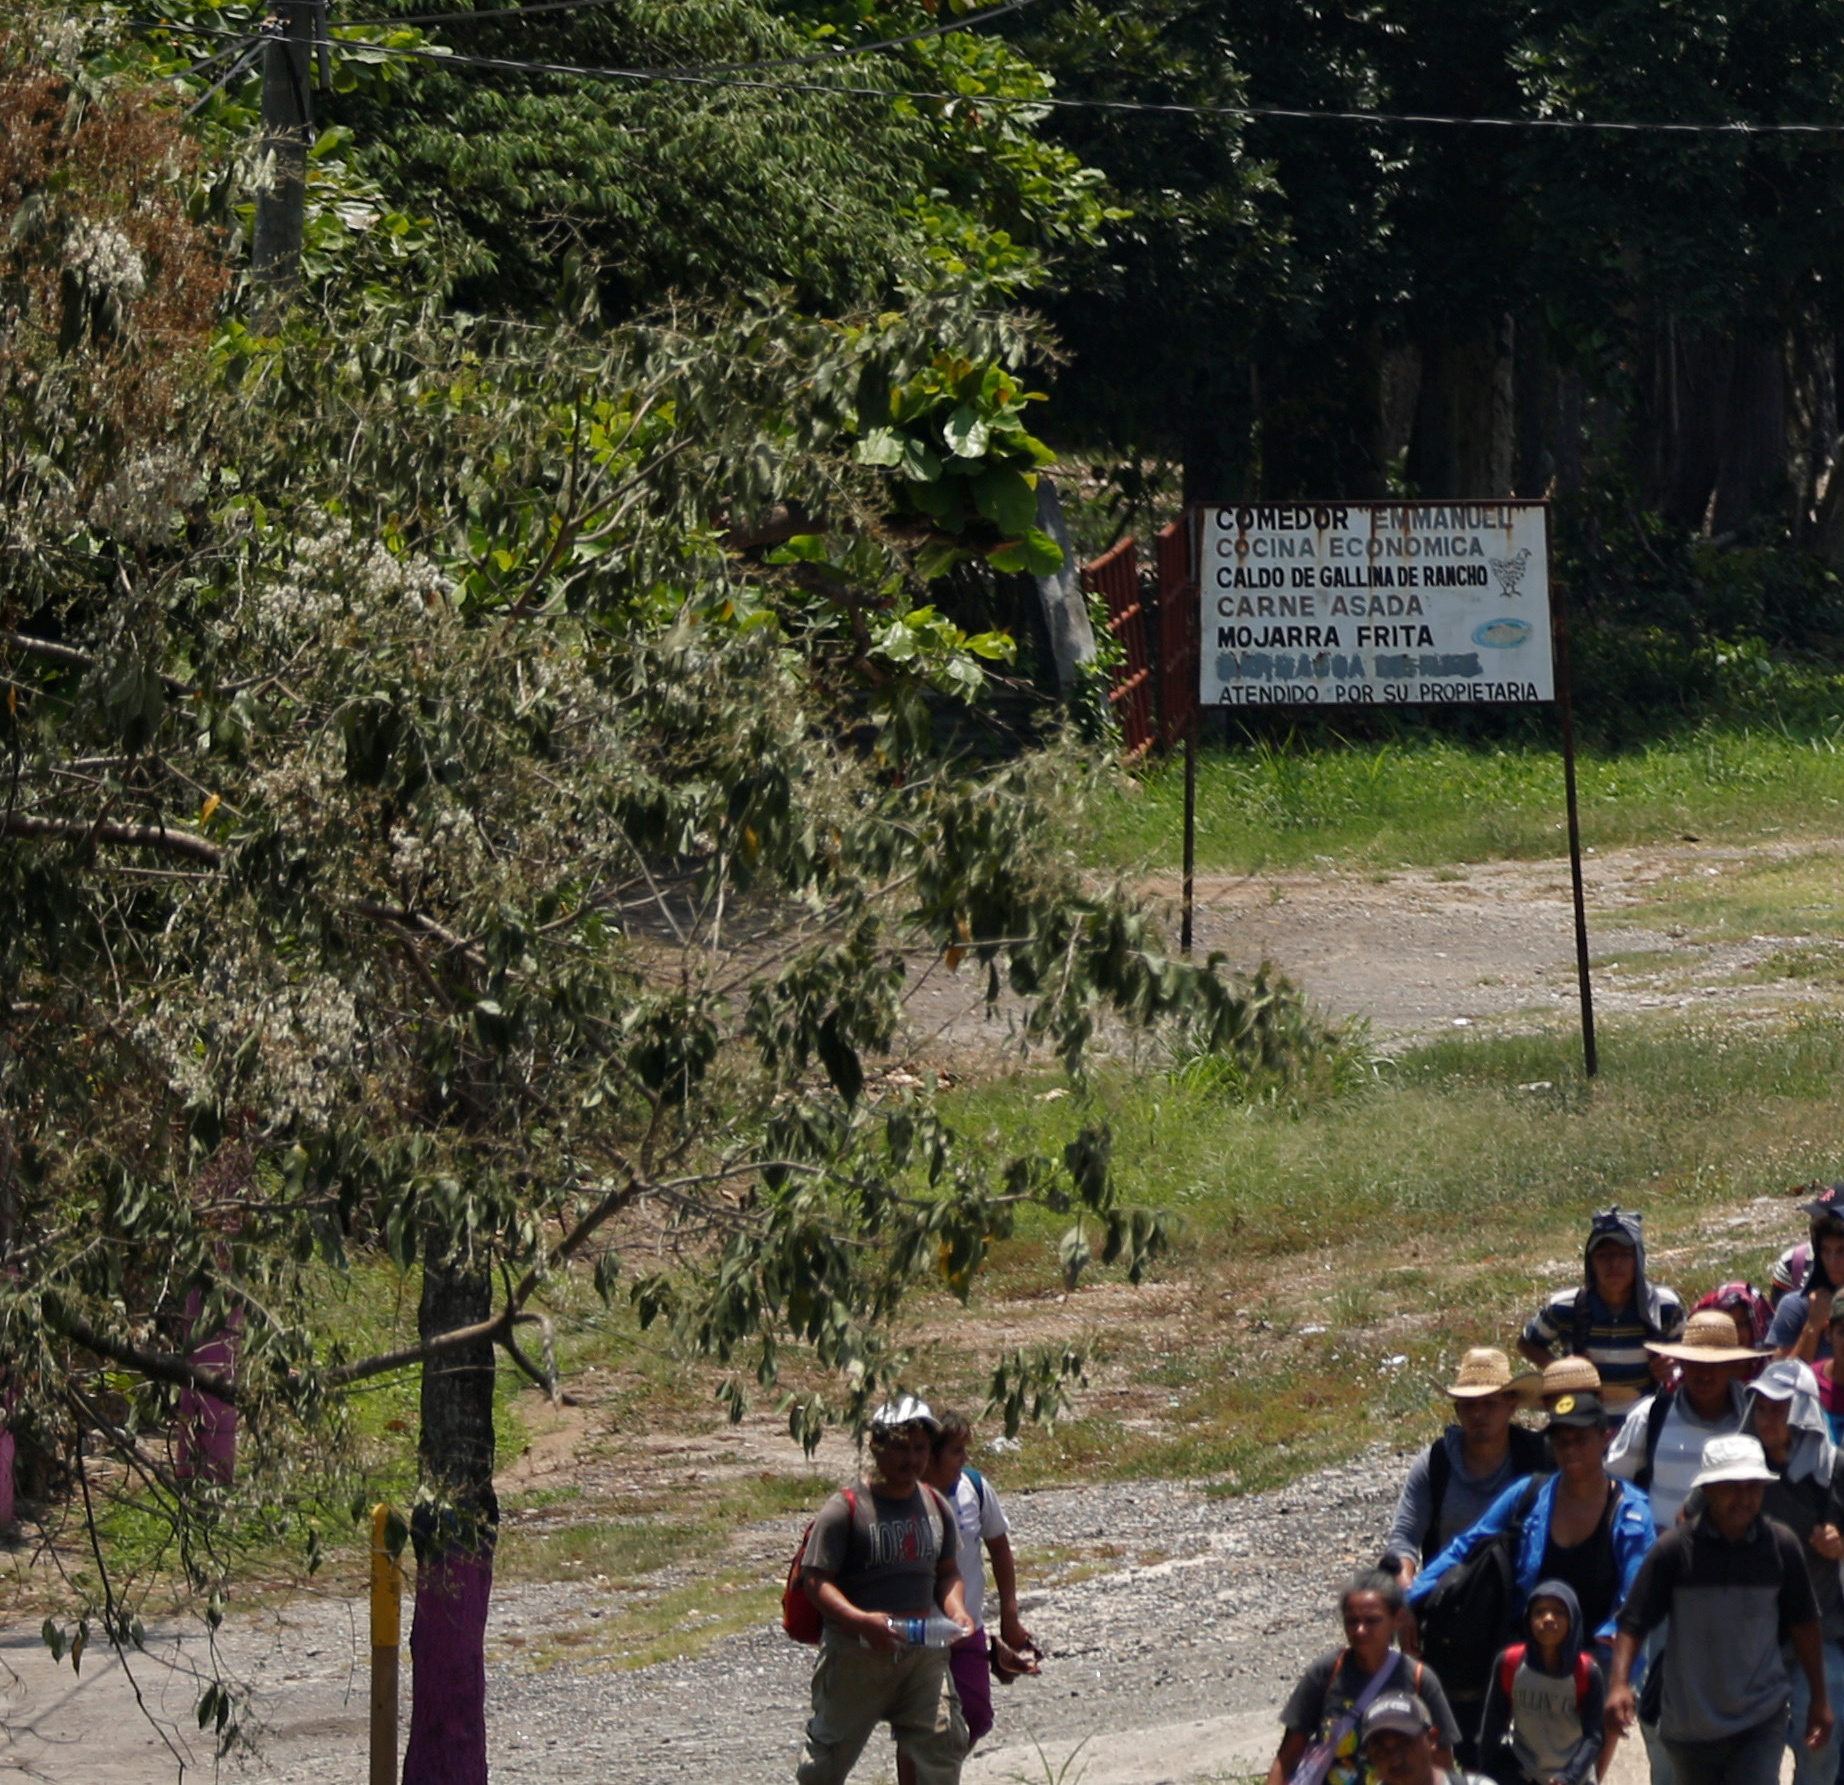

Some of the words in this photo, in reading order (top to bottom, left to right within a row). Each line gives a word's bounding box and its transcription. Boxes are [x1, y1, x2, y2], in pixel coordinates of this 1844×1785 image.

[1216, 507, 1348, 530] COMEDOR
[1216, 537, 1316, 558] COCINA
[1329, 536, 1485, 557] ECONOMICA
[1216, 566, 1285, 588] CALDO
[1291, 567, 1315, 588] DE
[1320, 565, 1395, 588] GALLINA
[1398, 565, 1419, 587] DE
[1423, 564, 1488, 587] RANCHO
[1217, 595, 1315, 617] CARNE
[1330, 594, 1424, 617] ASADA
[1218, 625, 1341, 648] MOJARRA
[1357, 624, 1434, 647] FRITA
[1219, 685, 1319, 704] ATENDIDO
[1335, 684, 1374, 703] POR
[1383, 683, 1409, 703] SU
[1419, 681, 1538, 703] PROPIETARIA
